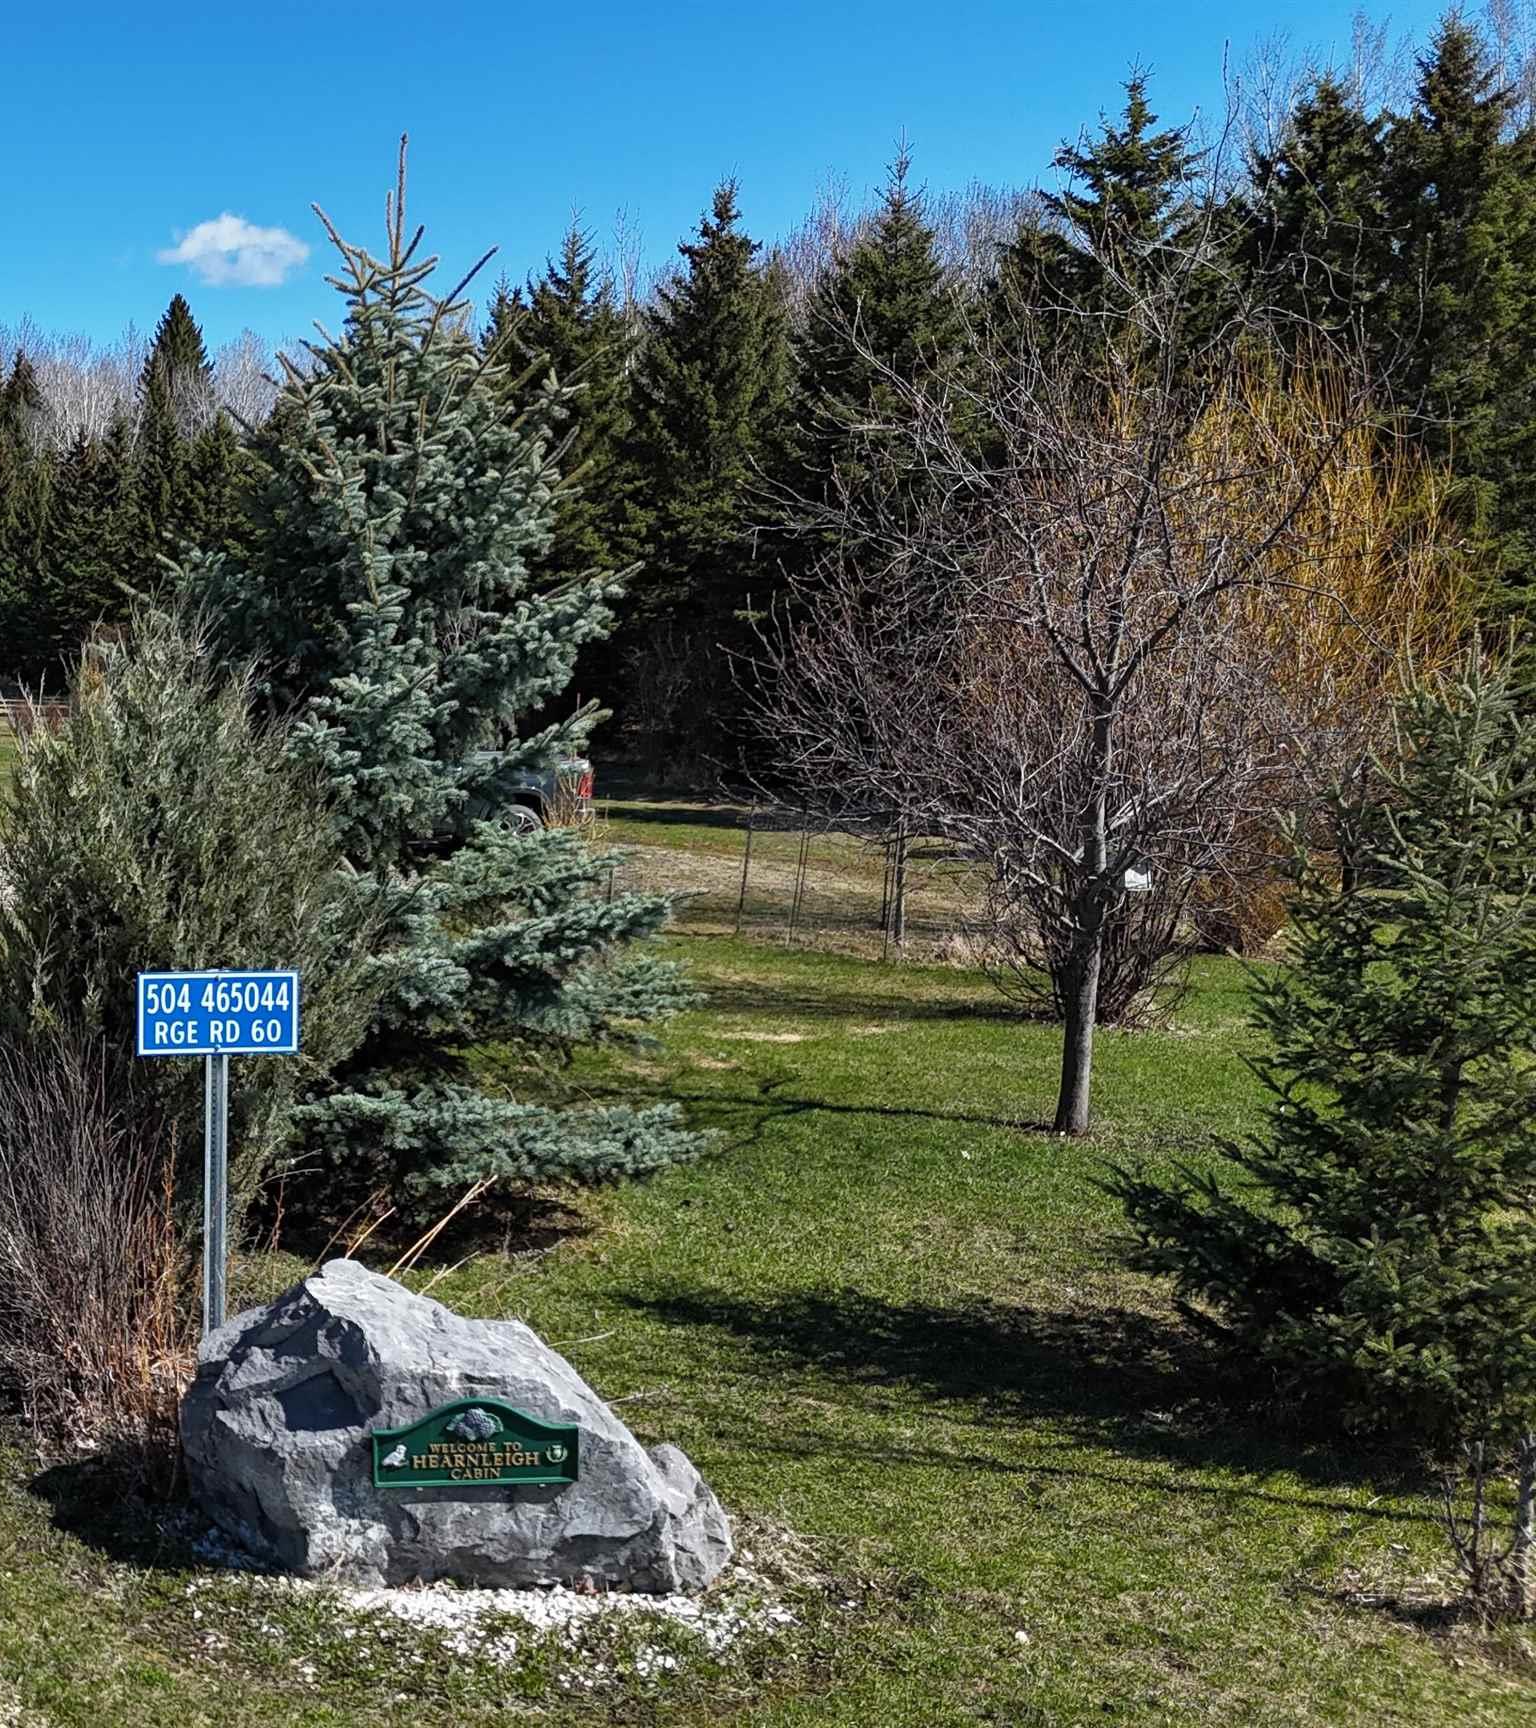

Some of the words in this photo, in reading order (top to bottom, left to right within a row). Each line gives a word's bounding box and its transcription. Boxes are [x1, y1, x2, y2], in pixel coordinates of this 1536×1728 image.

[147, 983, 191, 1014] 504
[201, 981, 289, 1013] 465044
[155, 1020, 198, 1045] RGE
[210, 1020, 240, 1043] RD
[251, 1019, 282, 1043] 60
[429, 1442, 496, 1454] WELCOME
[503, 1441, 522, 1452] TO
[412, 1452, 539, 1469] HEARNLEIGH
[450, 1467, 501, 1480] CABIN
